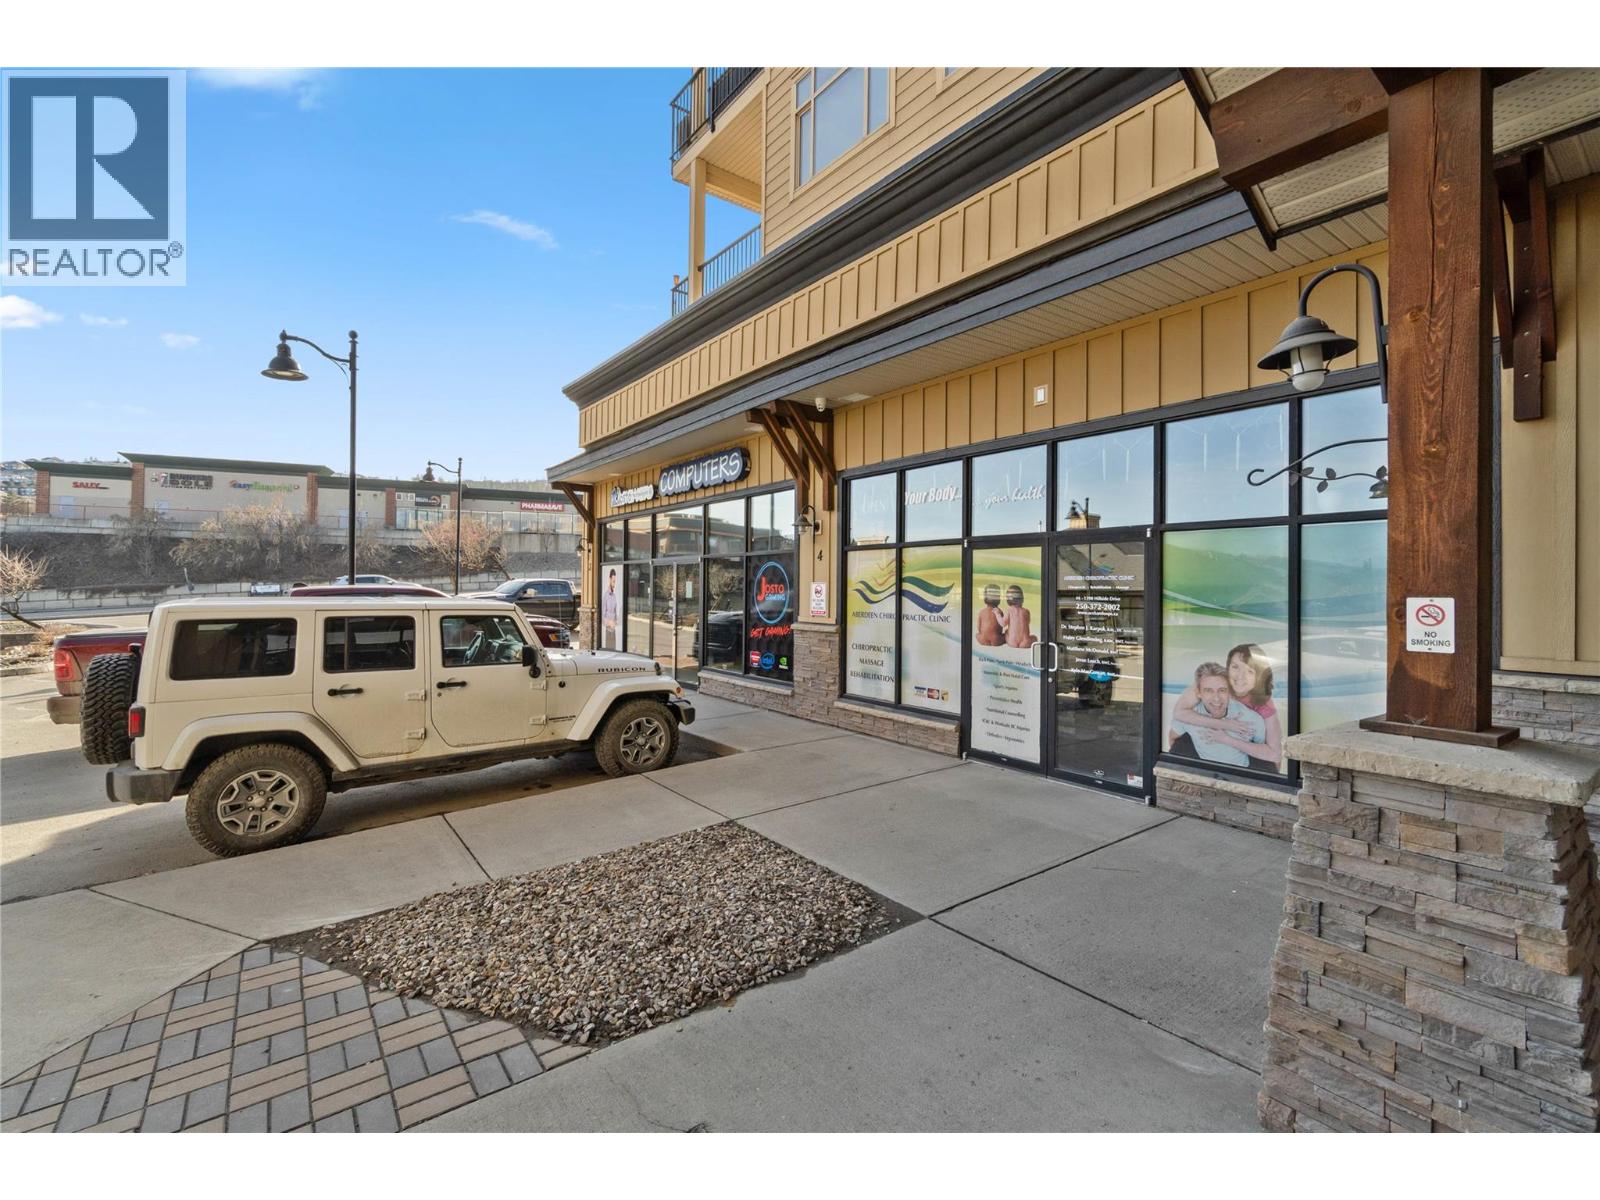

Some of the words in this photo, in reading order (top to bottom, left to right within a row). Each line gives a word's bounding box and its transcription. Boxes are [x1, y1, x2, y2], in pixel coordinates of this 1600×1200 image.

[660, 452, 740, 492] COMPUTERS
[904, 491, 927, 506] Your
[521, 502, 564, 511] PHARMASAVE
[817, 550, 823, 561] 4
[765, 593, 785, 601] GAMING
[1075, 603, 1121, 611] 250-372-2002
[852, 611, 878, 620] ABERDEEN
[929, 614, 951, 623] CLINIC
[751, 626, 763, 638] GET
[851, 643, 893, 654] CHIROPRACTIC
[1411, 639, 1451, 647] SMOKING
[859, 658, 884, 667] MASSAGE
[850, 671, 895, 683] REHABILITATION
